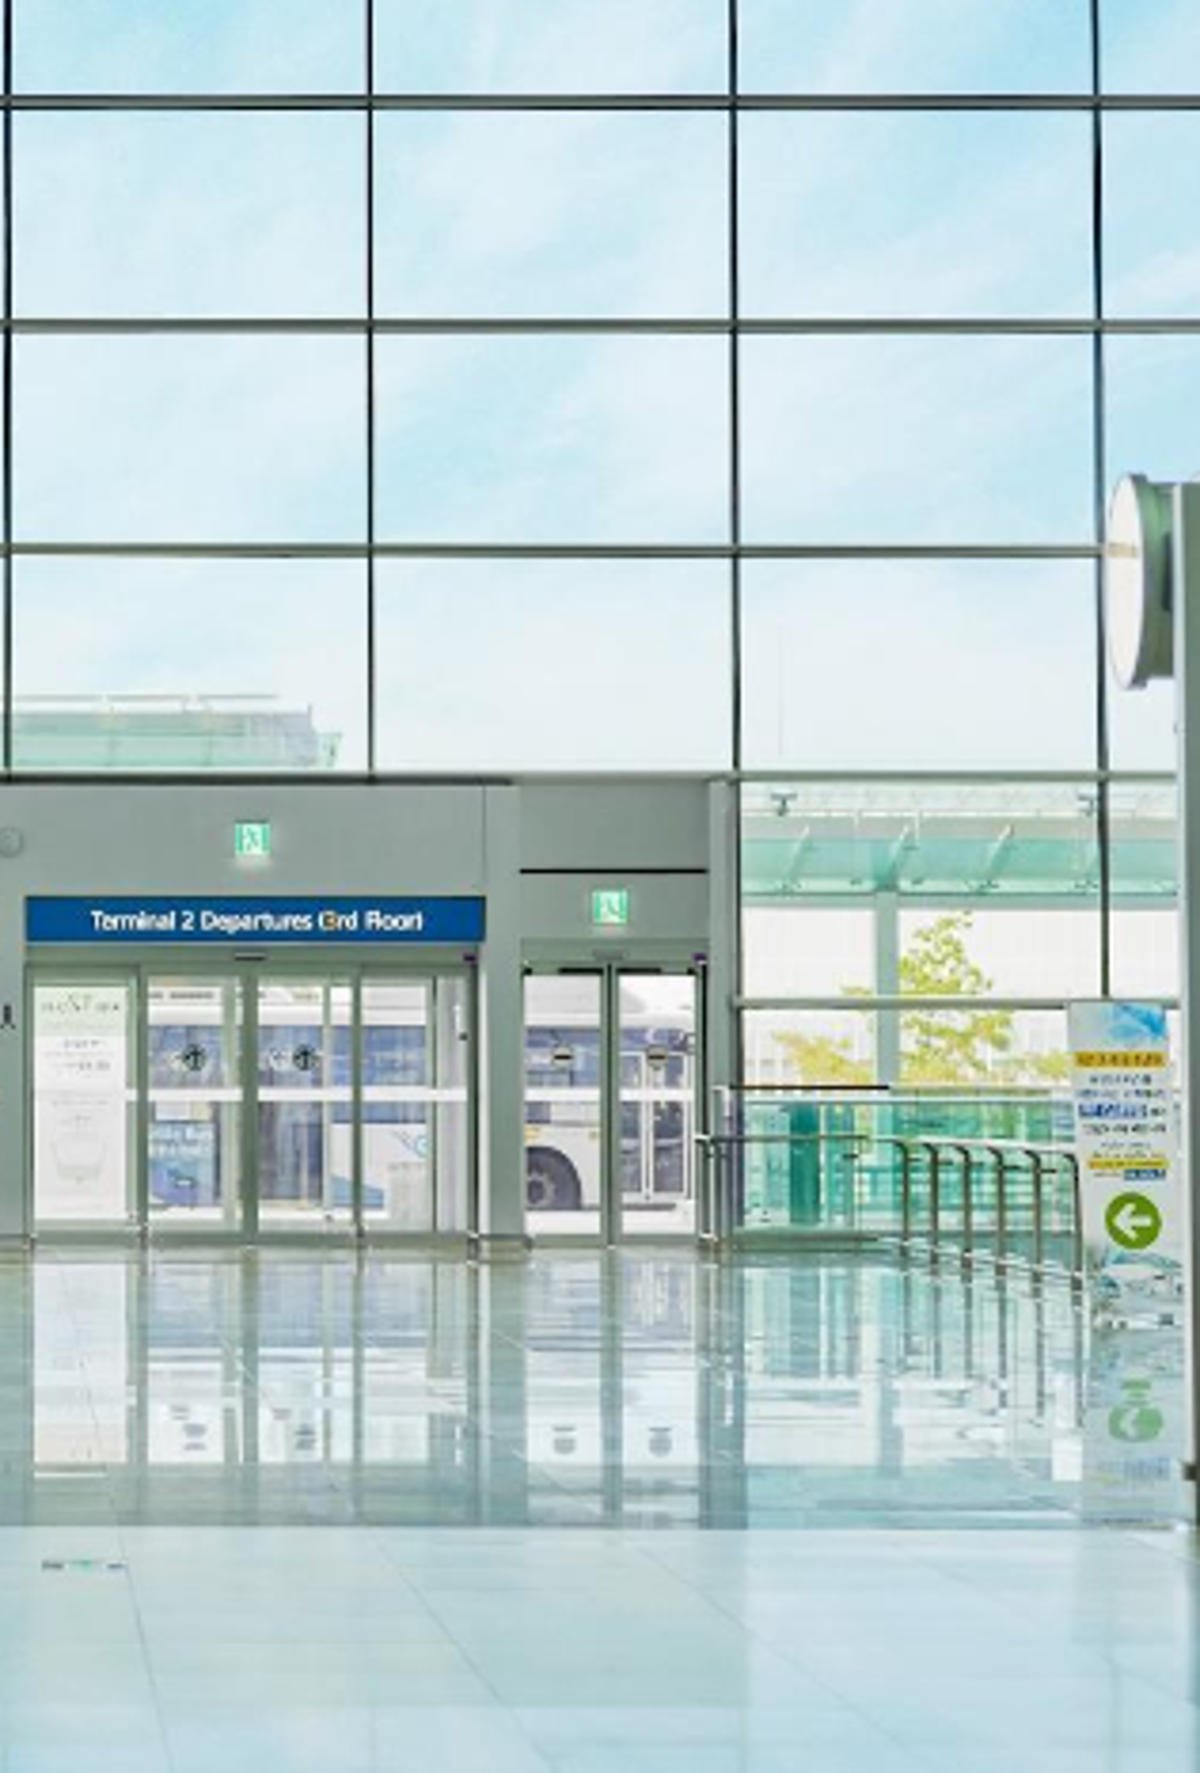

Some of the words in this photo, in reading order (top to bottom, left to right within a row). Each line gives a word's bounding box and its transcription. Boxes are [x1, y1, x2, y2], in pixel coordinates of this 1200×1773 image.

[90, 910, 176, 931] Terminal
[181, 910, 195, 931] 2
[201, 910, 313, 936] Departures
[318, 910, 358, 932] (3rd
